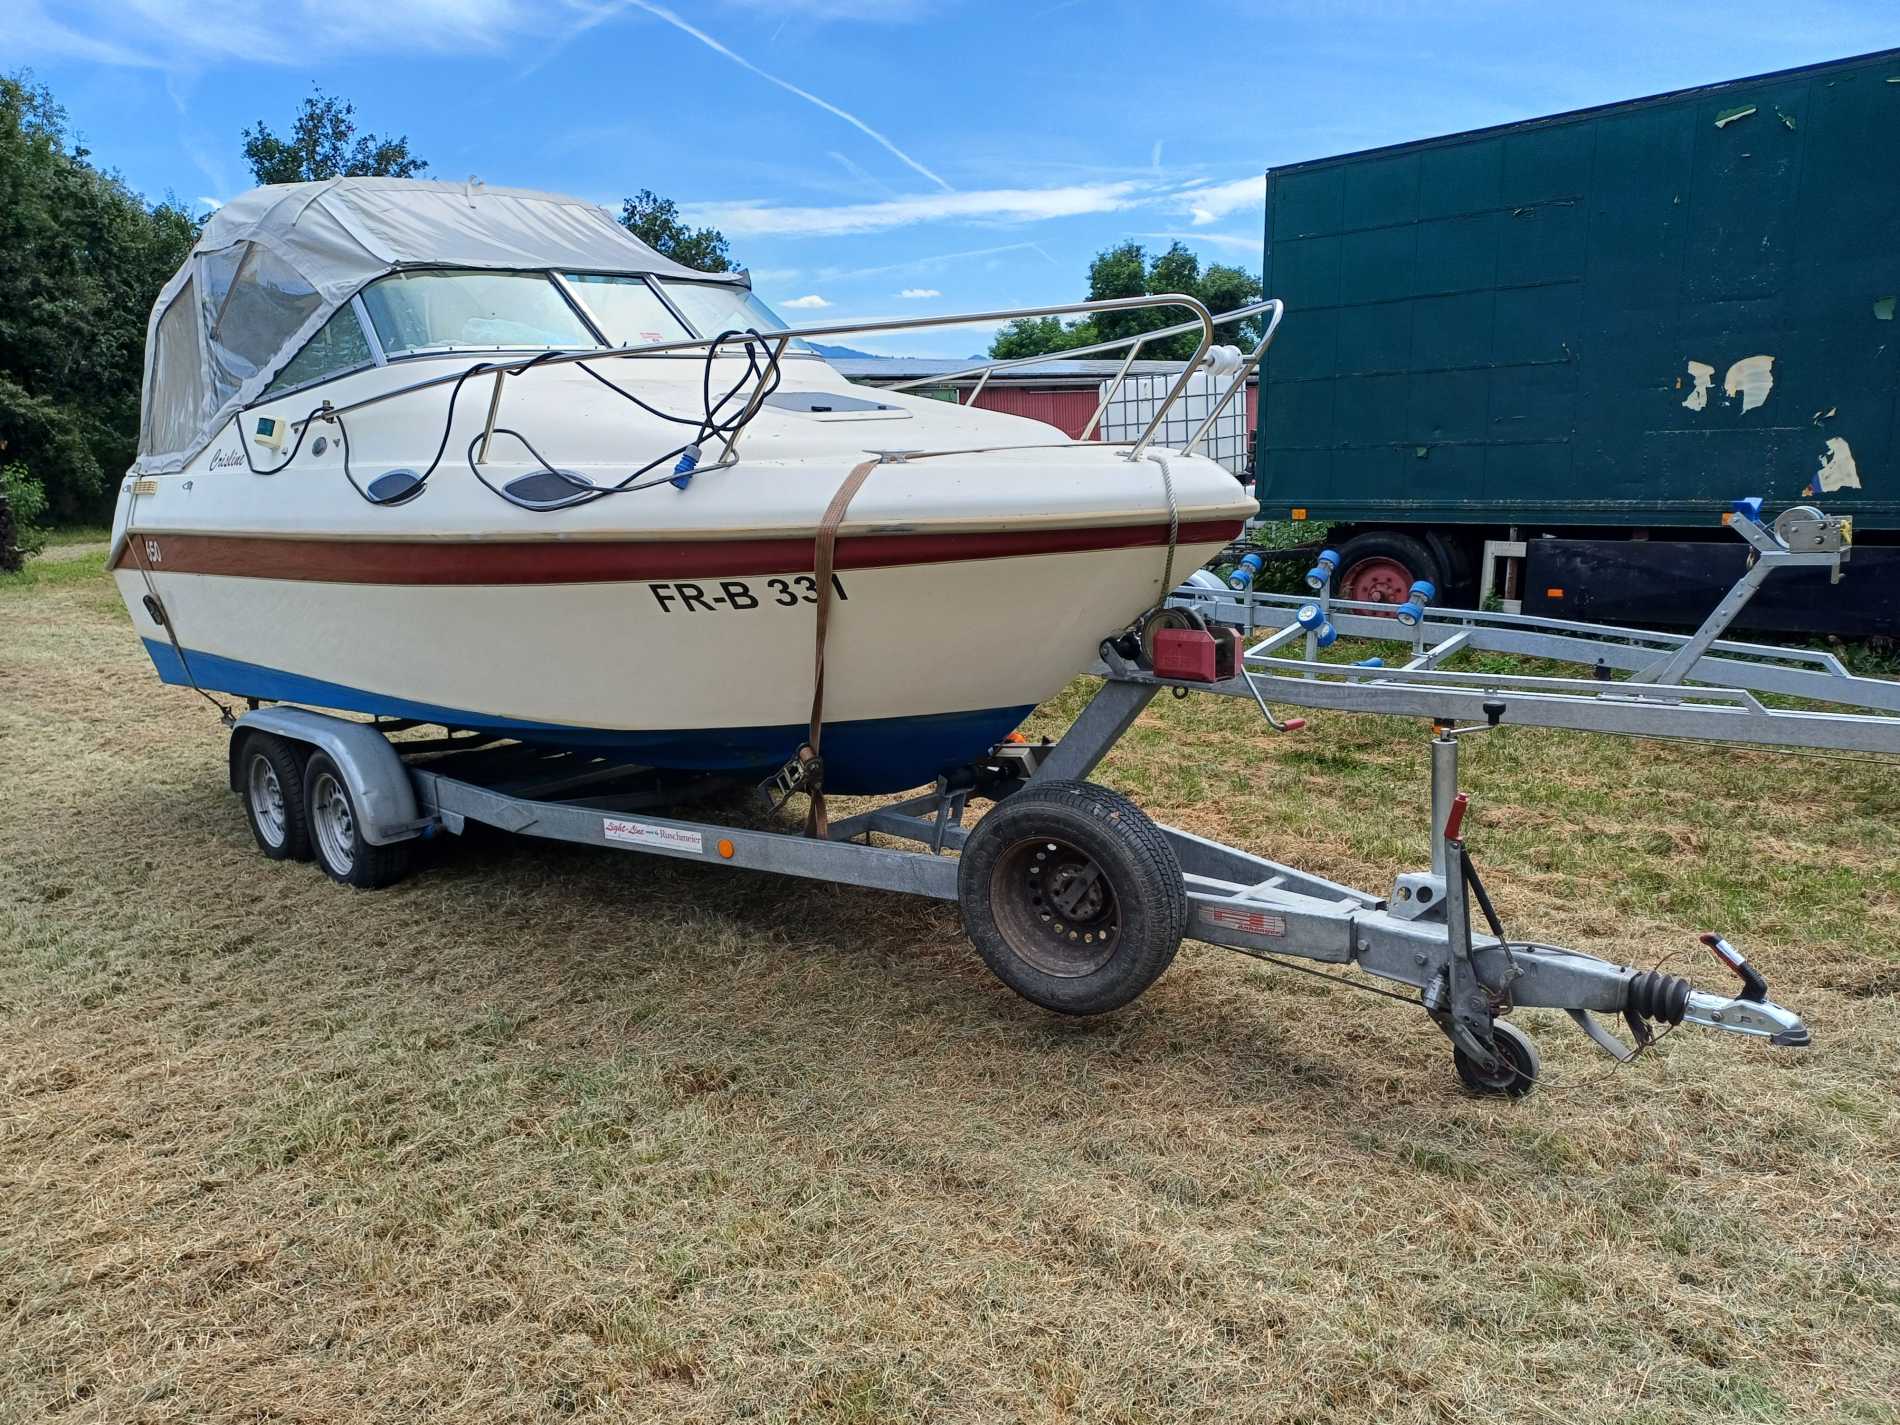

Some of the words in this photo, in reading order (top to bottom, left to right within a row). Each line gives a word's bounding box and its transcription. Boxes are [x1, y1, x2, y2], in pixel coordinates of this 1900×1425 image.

[145, 540, 162, 562] 650
[648, 581, 759, 613] FR-B
[767, 573, 849, 607] 331
